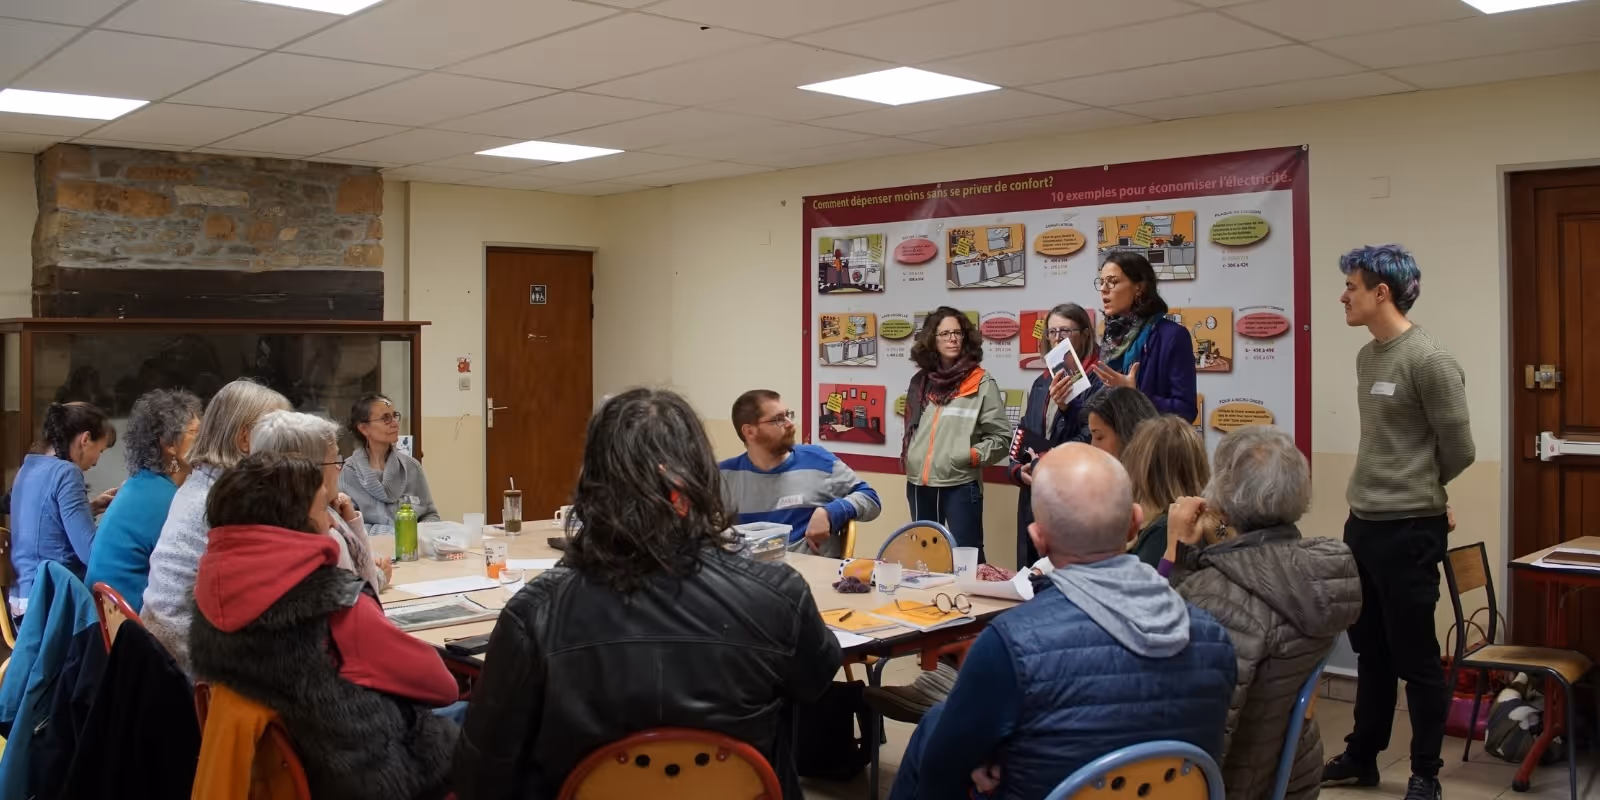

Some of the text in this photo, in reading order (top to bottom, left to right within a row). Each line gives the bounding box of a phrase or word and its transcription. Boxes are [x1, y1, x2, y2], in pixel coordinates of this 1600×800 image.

[813, 176, 1054, 210] Comment dépenser moins sans se priver de confort?
[1050, 190, 1065, 203] 10
[1066, 188, 1117, 202] exemples
[1119, 185, 1145, 199] pour
[1148, 178, 1216, 194] économiser
